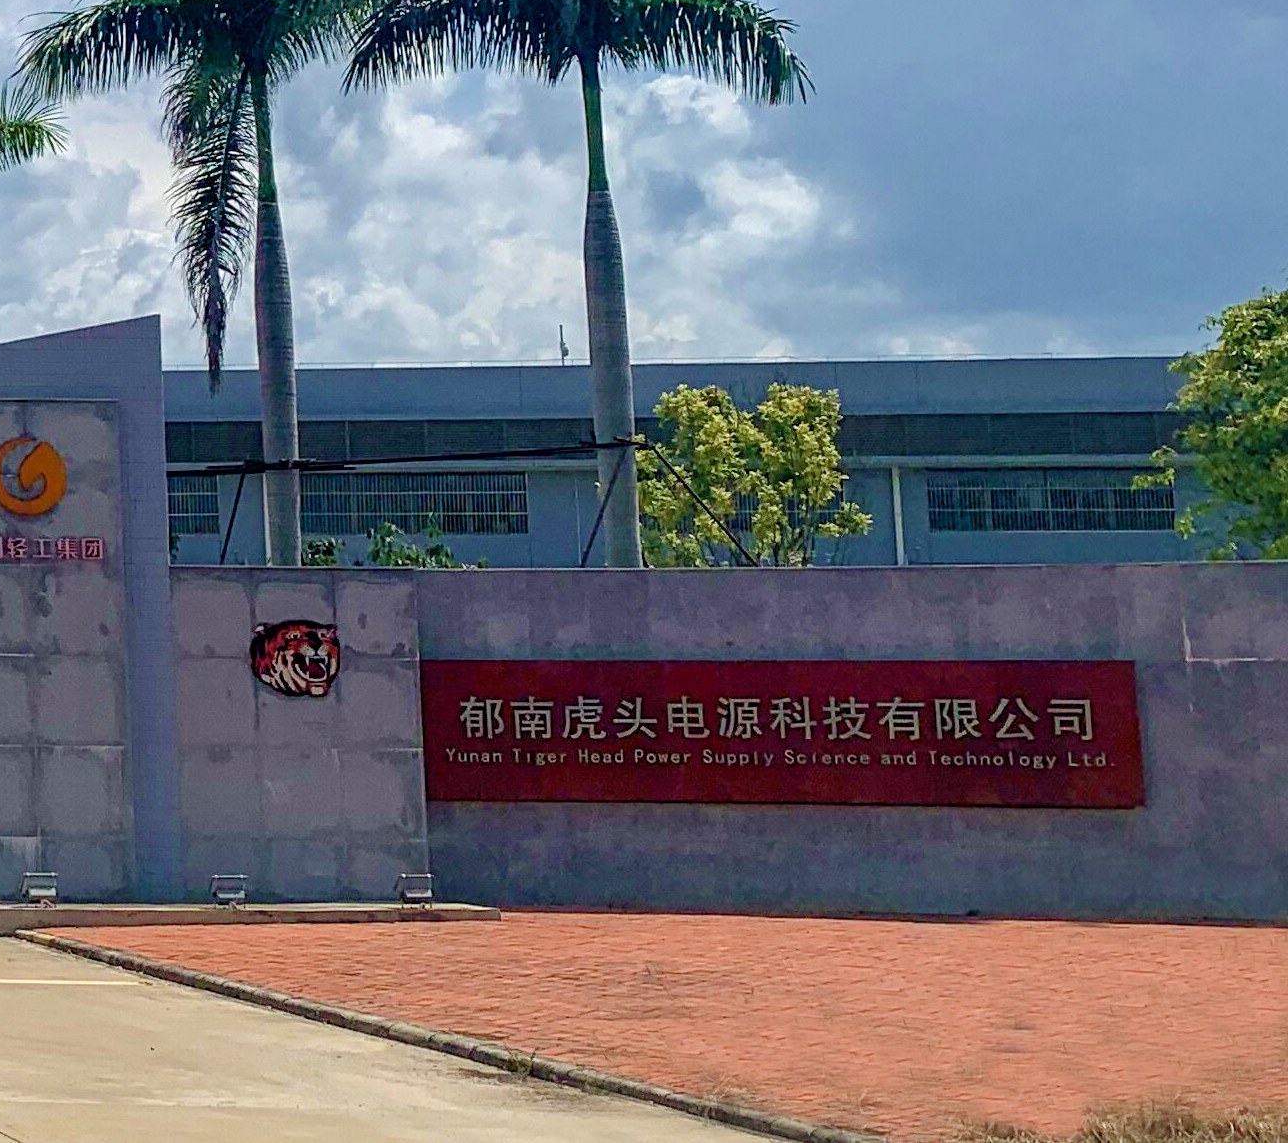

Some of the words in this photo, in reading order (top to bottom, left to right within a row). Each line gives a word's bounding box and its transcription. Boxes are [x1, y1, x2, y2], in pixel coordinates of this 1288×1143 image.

[459, 695, 1093, 741] 郁南虎头电源科技有限公司
[445, 747, 503, 764] Yunan
[512, 747, 568, 766] Tiger
[578, 748, 625, 764] Head
[634, 748, 691, 765] Power
[702, 749, 775, 767] Supply
[784, 749, 871, 766] Science
[880, 751, 917, 766] and
[929, 751, 1057, 769] Technology
[1068, 751, 1116, 768] Ltd.
